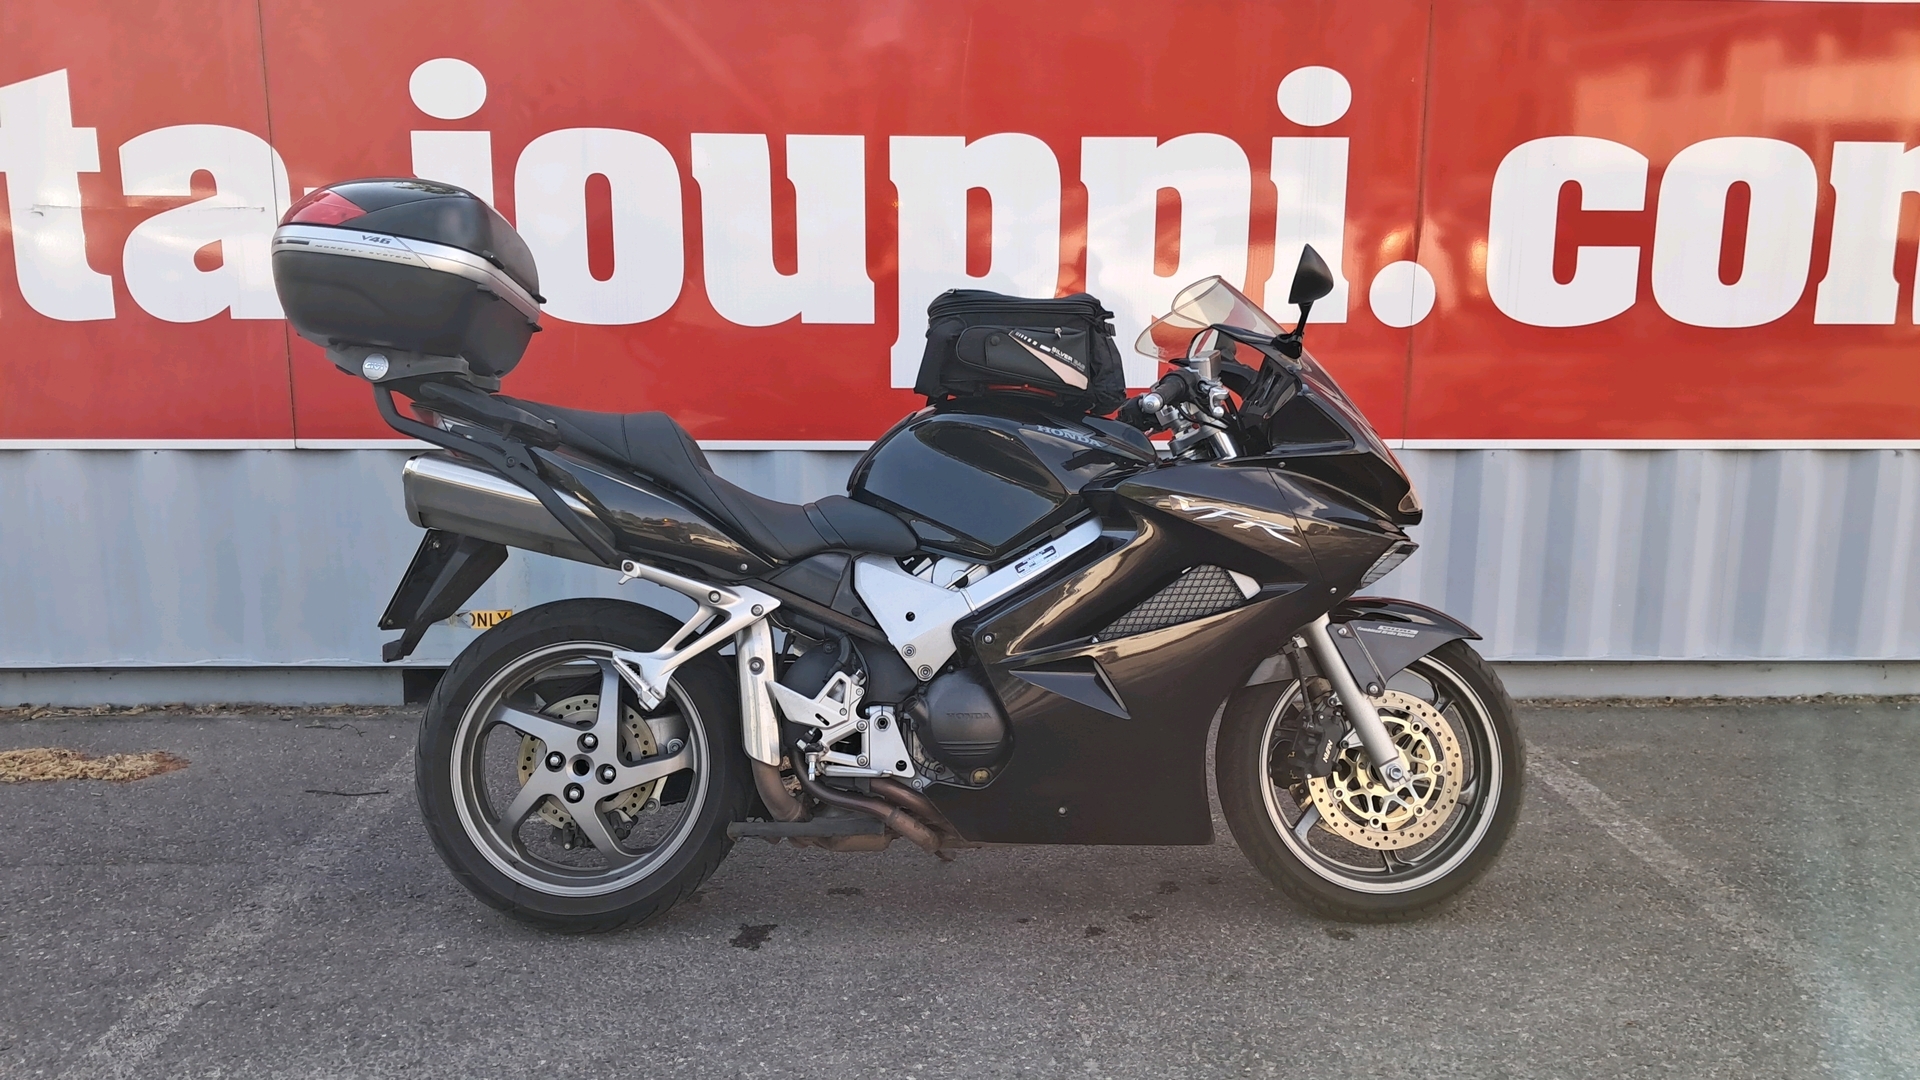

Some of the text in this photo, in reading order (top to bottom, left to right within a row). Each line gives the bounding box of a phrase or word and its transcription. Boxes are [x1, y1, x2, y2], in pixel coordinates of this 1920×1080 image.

[0, 58, 1920, 388] taouppi.co
[361, 234, 392, 245] V46
[1037, 424, 1104, 448] HONDA
